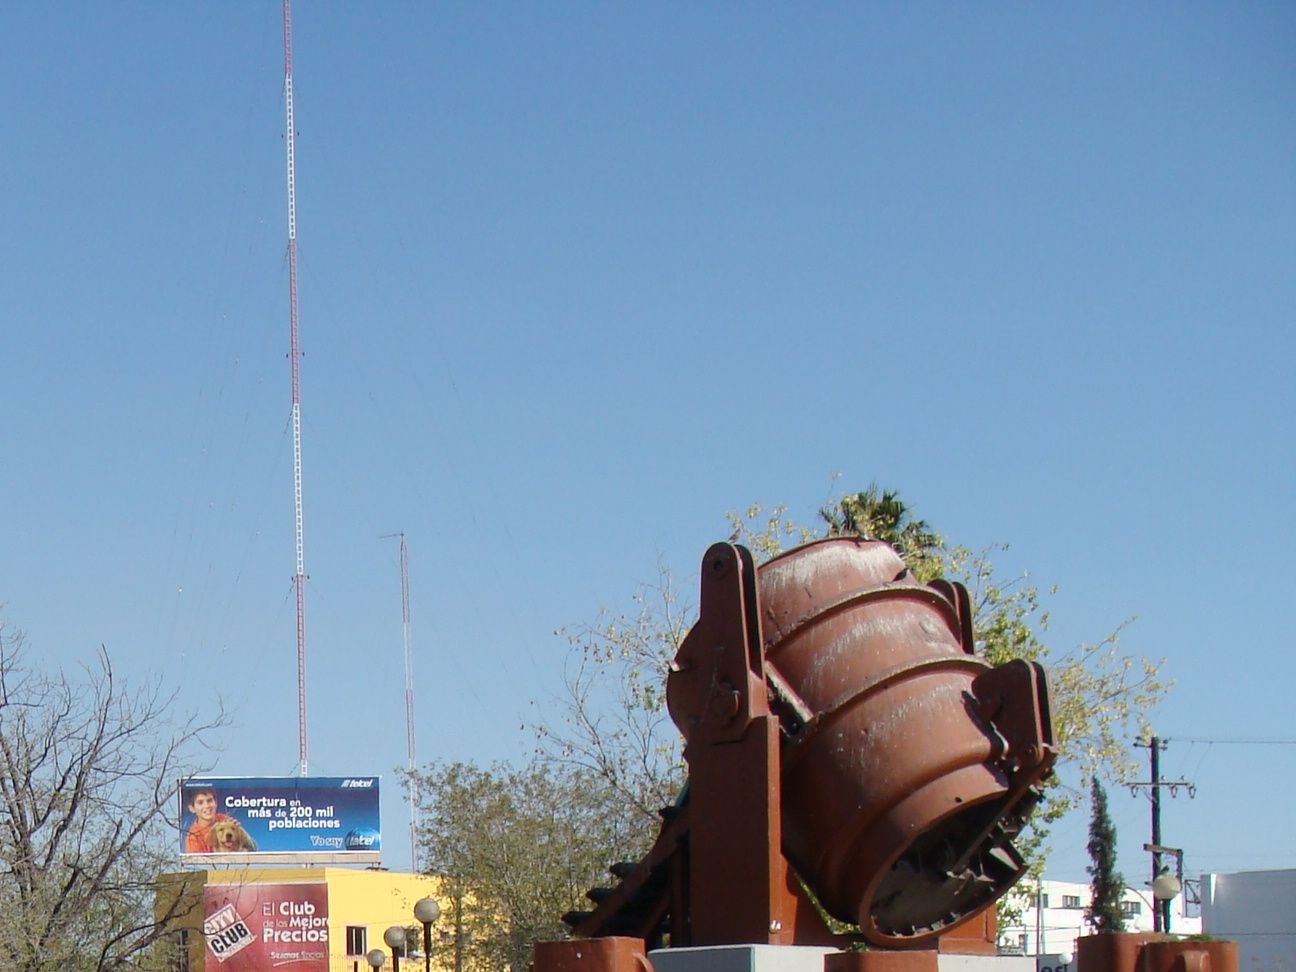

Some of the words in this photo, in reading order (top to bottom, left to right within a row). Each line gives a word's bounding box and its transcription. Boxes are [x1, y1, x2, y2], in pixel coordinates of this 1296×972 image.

[225, 796, 286, 807] Cobertura
[248, 806, 272, 818] más
[275, 808, 287, 818] de
[290, 807, 312, 818] 200
[316, 806, 334, 818] mil
[269, 817, 340, 831] poblaciones
[310, 835, 325, 846] Yo
[326, 837, 343, 848] soy
[263, 902, 275, 916] El
[279, 901, 315, 915] Club
[262, 918, 274, 928] de
[211, 923, 248, 954] CLUB
[263, 928, 328, 943] Precios
